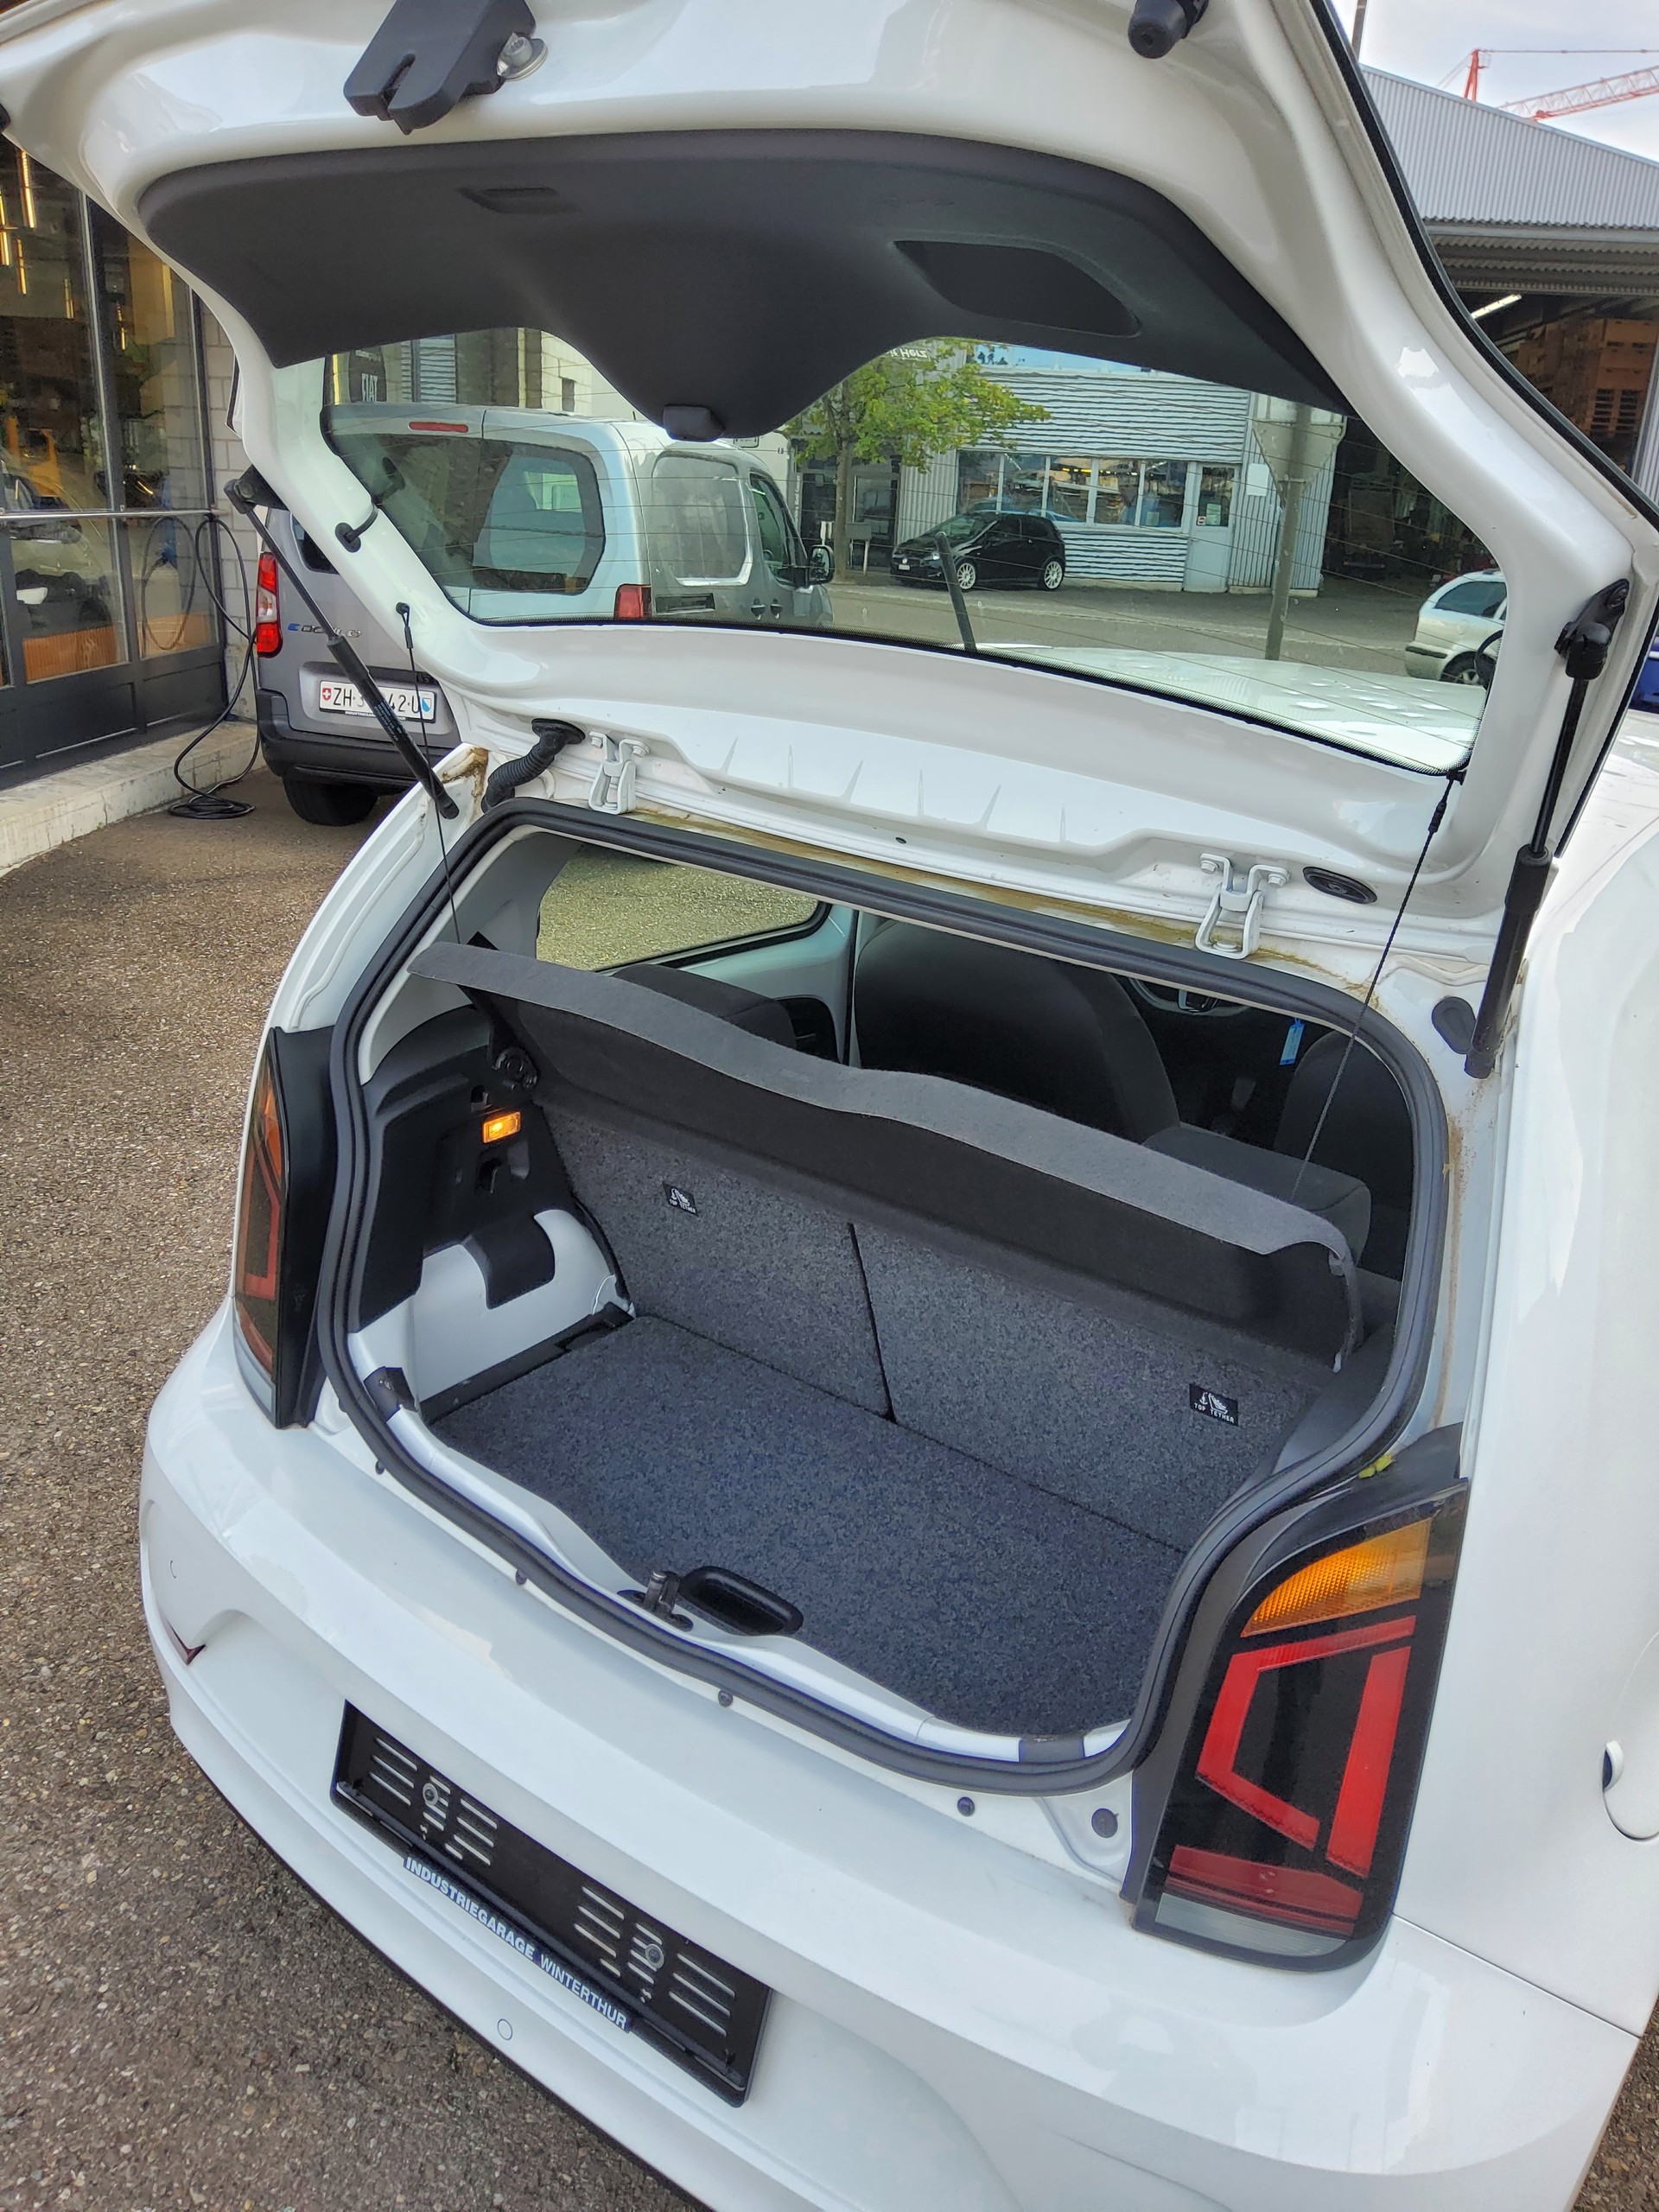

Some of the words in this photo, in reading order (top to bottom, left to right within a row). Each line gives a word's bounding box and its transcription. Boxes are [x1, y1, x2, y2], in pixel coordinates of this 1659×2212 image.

[361, 372, 378, 402] FIAT
[1193, 1402, 1206, 1412] TOP
[1210, 1408, 1235, 1424] TETHER
[405, 1856, 536, 1961] INDUSTRIEGARAGE
[540, 1954, 627, 2030] WINTERTHUR
